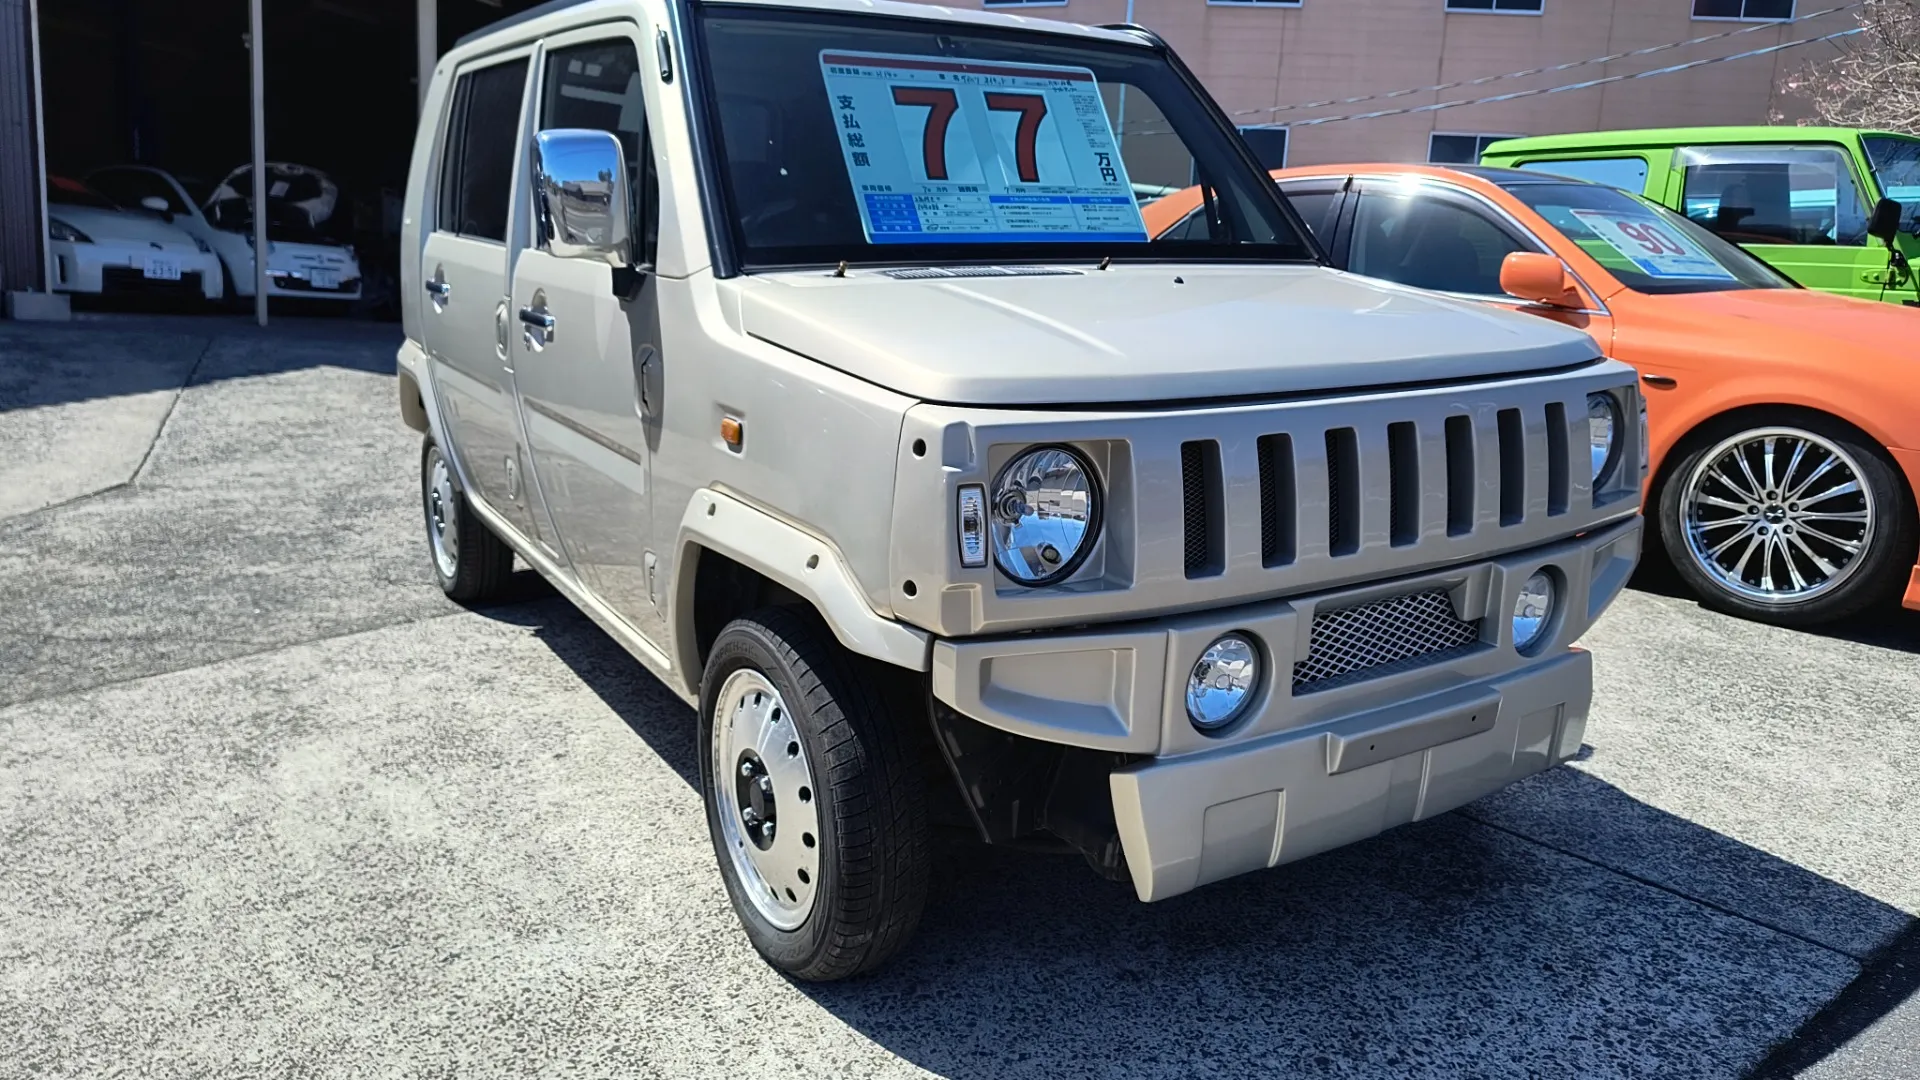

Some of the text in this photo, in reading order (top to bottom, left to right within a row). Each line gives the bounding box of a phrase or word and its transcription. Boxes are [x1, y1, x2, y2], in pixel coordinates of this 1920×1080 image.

[837, 95, 871, 167] 支払総額
[1094, 152, 1118, 182] 万円
[1616, 221, 1686, 255] 90
